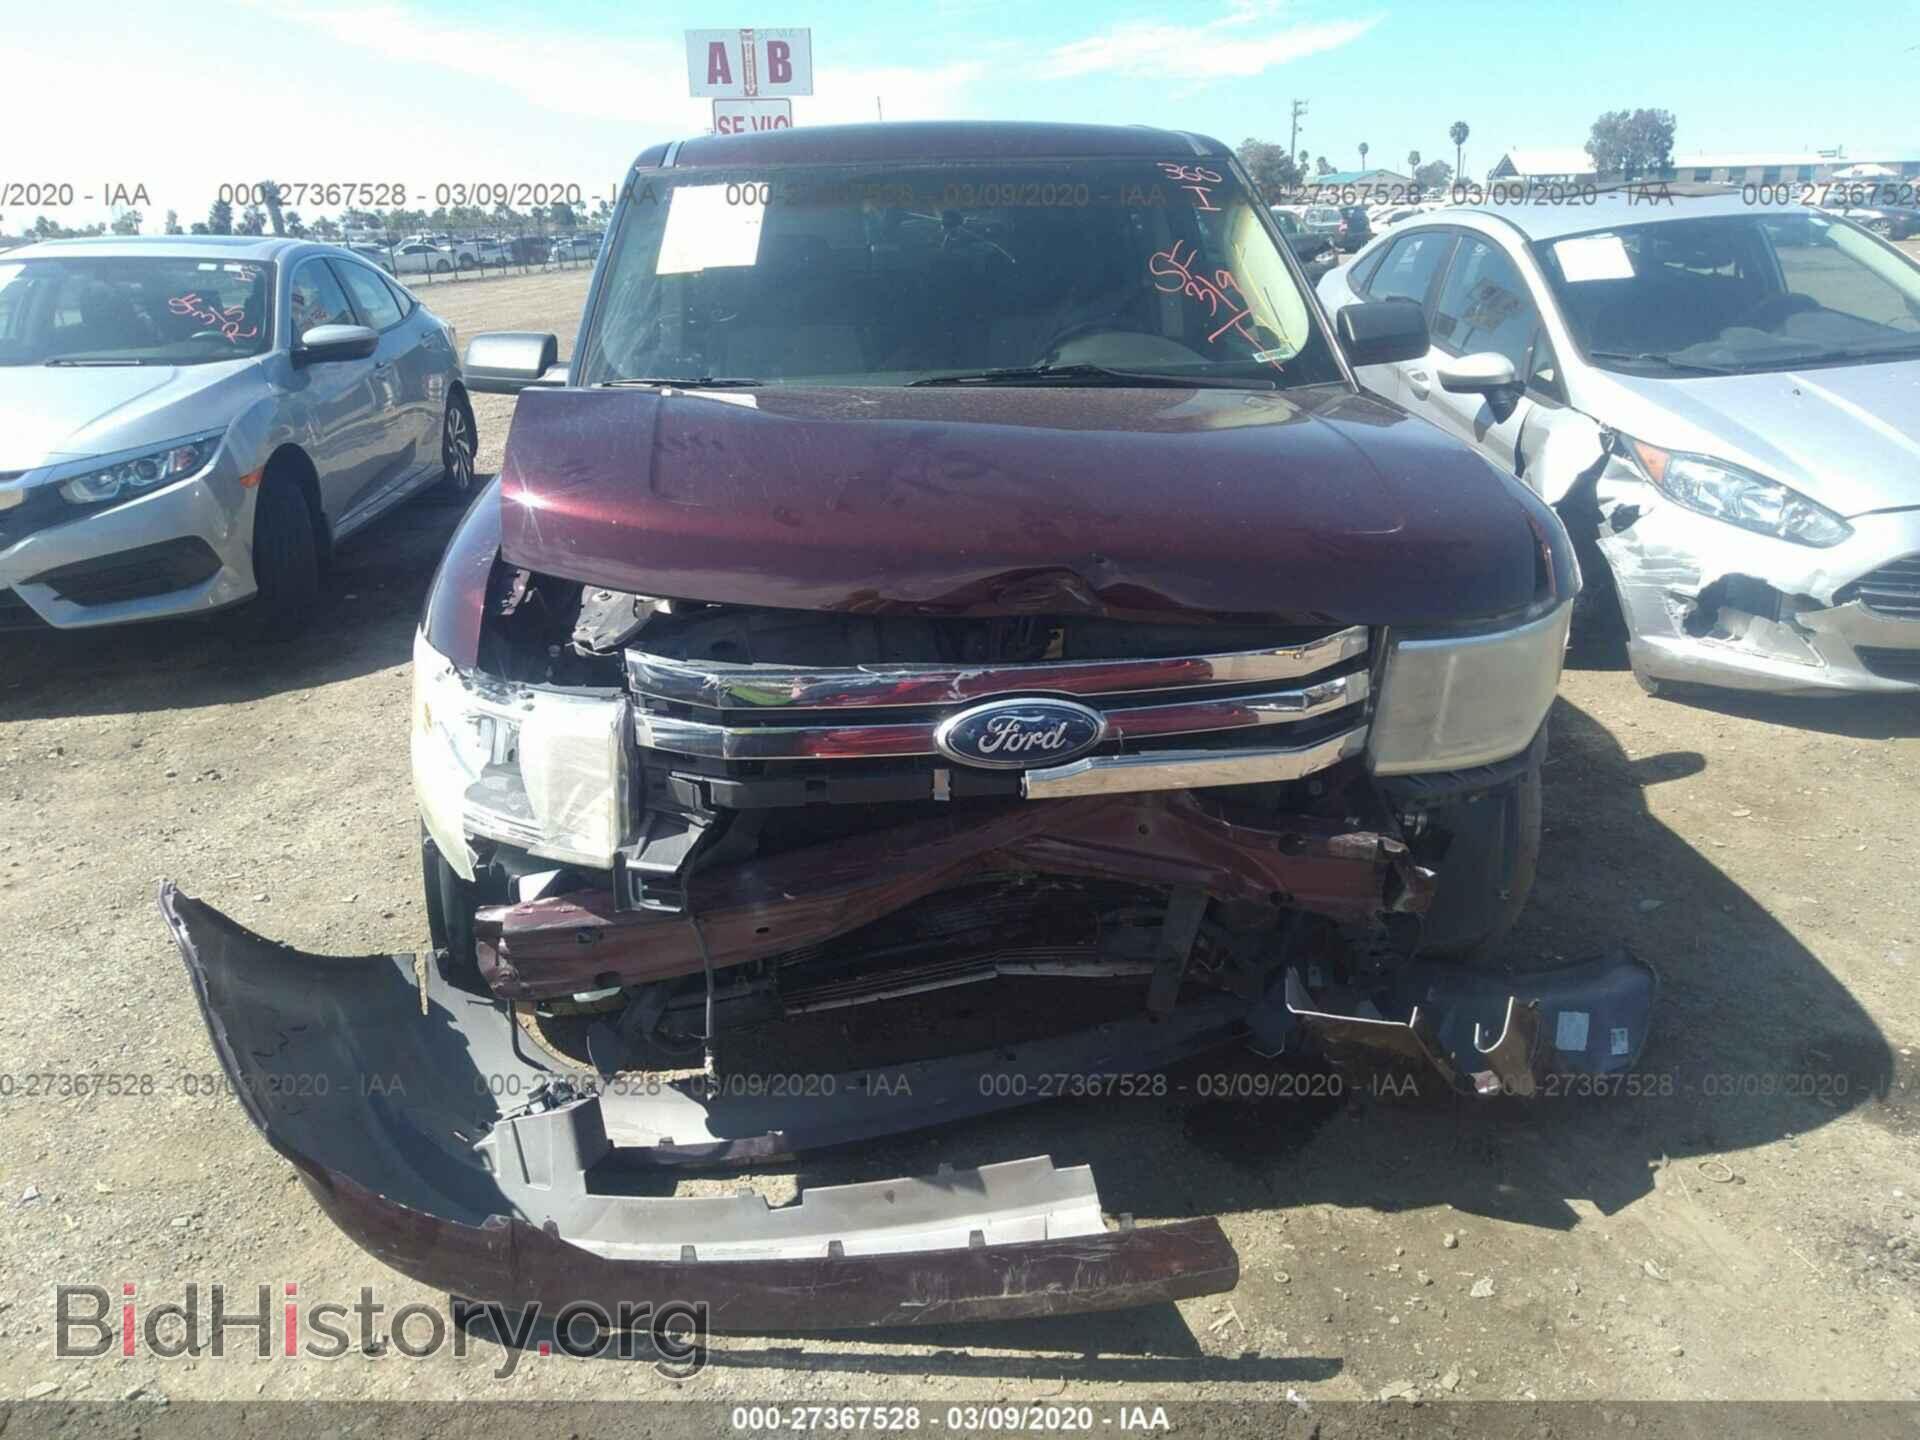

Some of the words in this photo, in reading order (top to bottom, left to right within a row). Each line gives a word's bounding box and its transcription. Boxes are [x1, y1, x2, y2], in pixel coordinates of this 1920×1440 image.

[707, 41, 733, 84] A
[767, 40, 793, 84] B
[977, 714, 1068, 754] Ford
